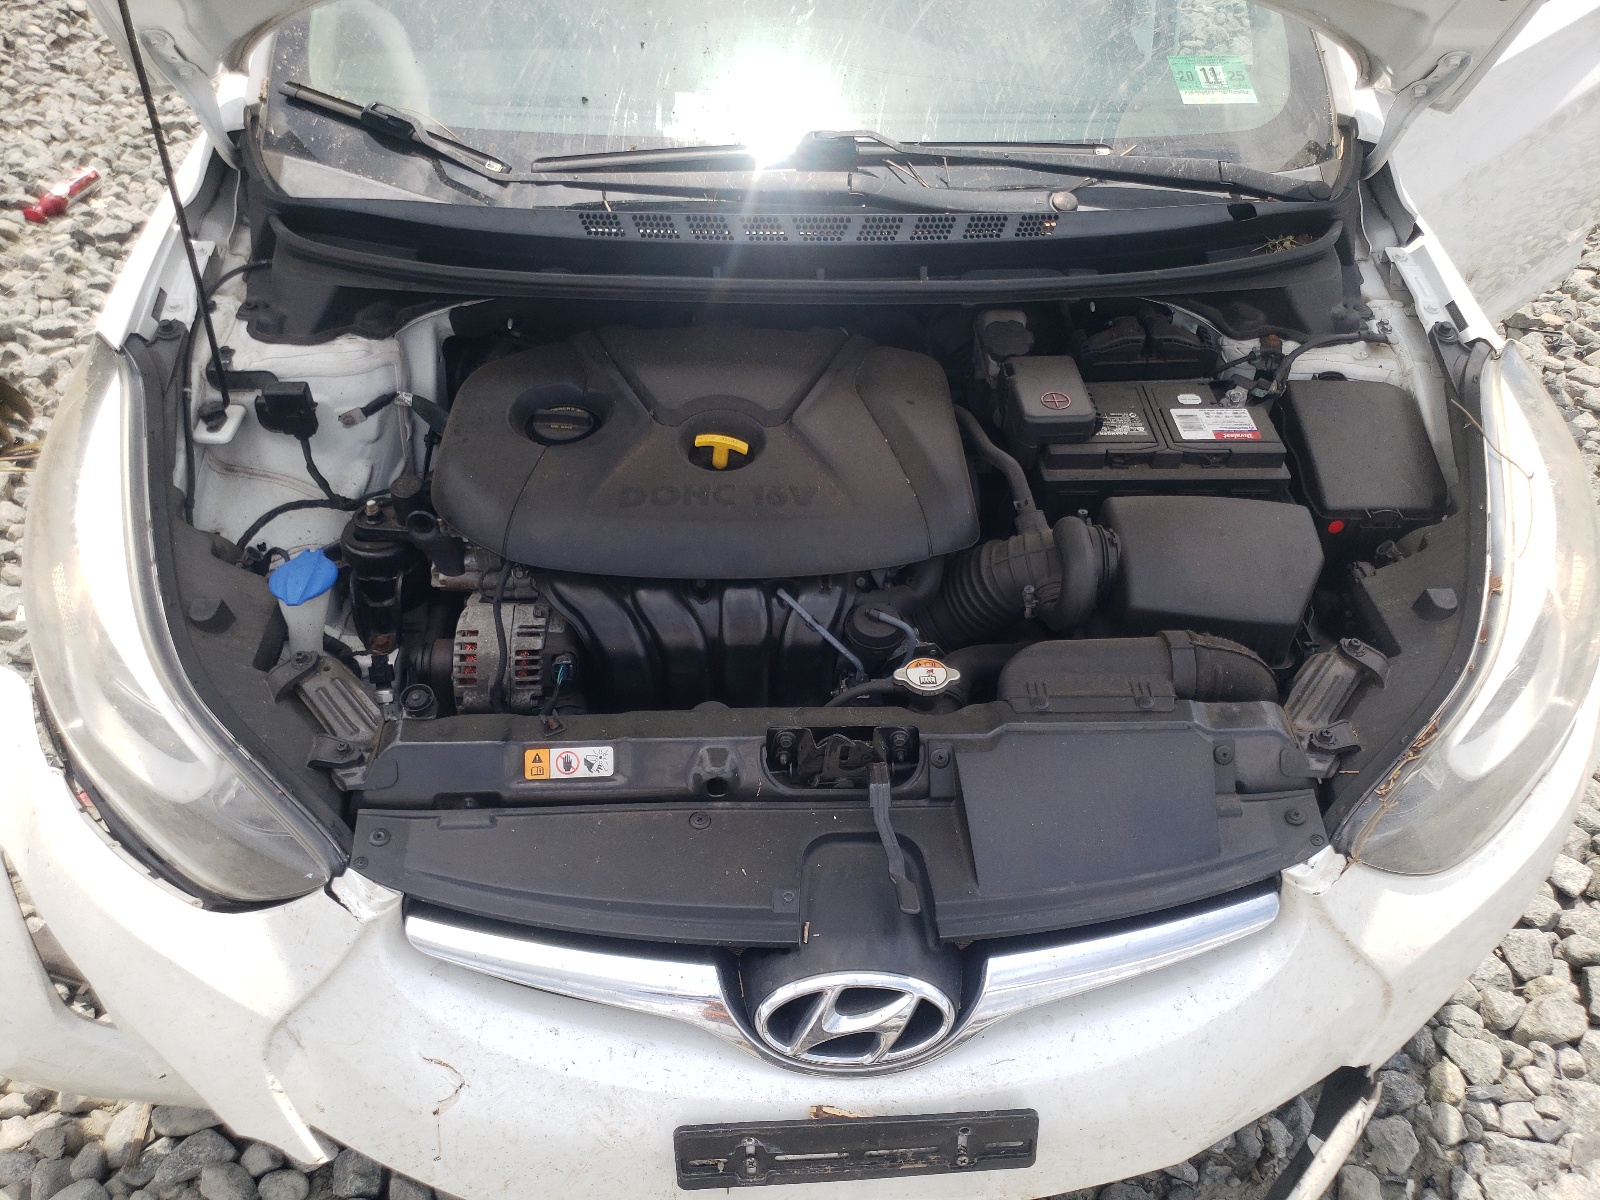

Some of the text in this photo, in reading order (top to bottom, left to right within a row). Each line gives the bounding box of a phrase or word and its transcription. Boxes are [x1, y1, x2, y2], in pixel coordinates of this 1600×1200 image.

[1177, 66, 1245, 84] 20 11 25
[619, 484, 819, 507] DOHC 16V
